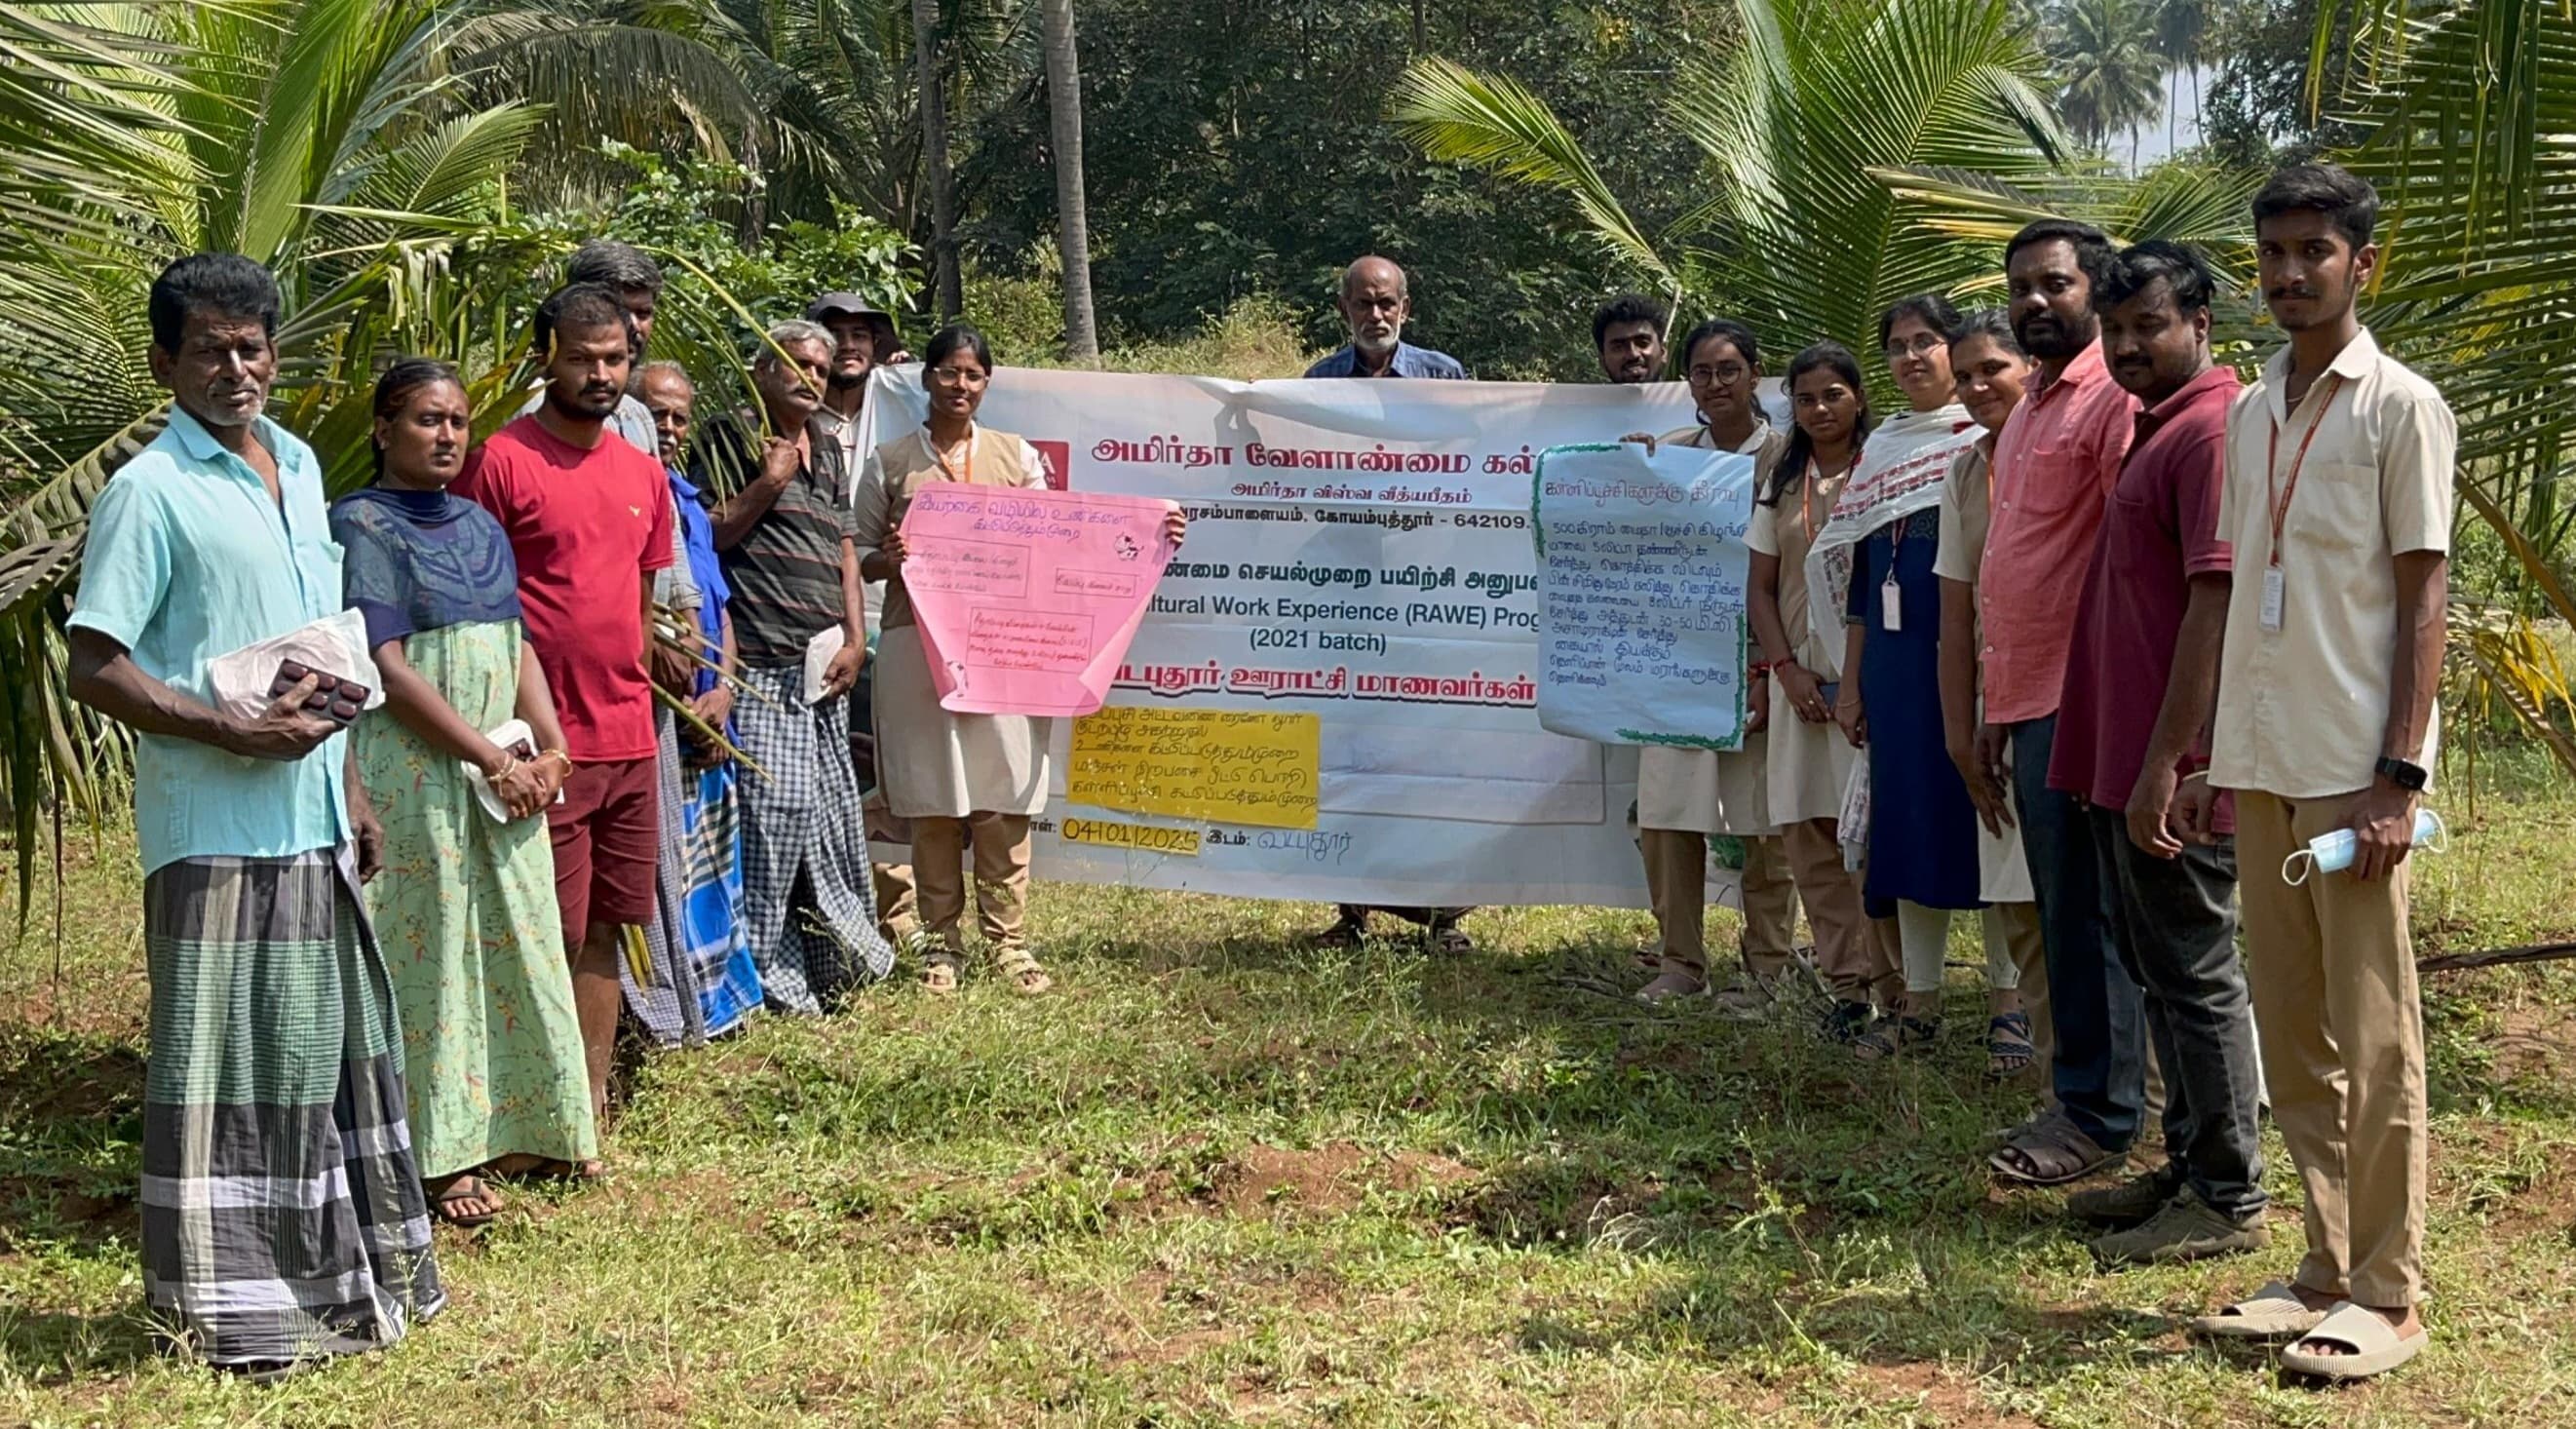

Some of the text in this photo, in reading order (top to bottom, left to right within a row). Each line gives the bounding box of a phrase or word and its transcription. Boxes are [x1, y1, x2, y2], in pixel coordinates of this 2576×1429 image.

[1091, 434, 1233, 470] அமிர்தா
[1246, 442, 1471, 474] வேளாண்மை
[1481, 444, 1536, 475] கல்
[1230, 482, 1307, 499] அமிர்தா
[1315, 509, 1434, 531] கோயம்புத்தூர்
[1163, 557, 1230, 579] ண்மை
[1239, 560, 1371, 587] செயல்முறை
[1380, 565, 1456, 592] பயிற்சி
[1211, 596, 1270, 616] Work
[1277, 598, 1399, 623] Experience
[1405, 602, 1486, 630] (RAWE)
[1493, 606, 1540, 633] Prog
[1250, 629, 1387, 657] (2021 batch)
[1229, 667, 1347, 691] ஊராட்சி
[1356, 671, 1536, 701] மாணவர்கள்
